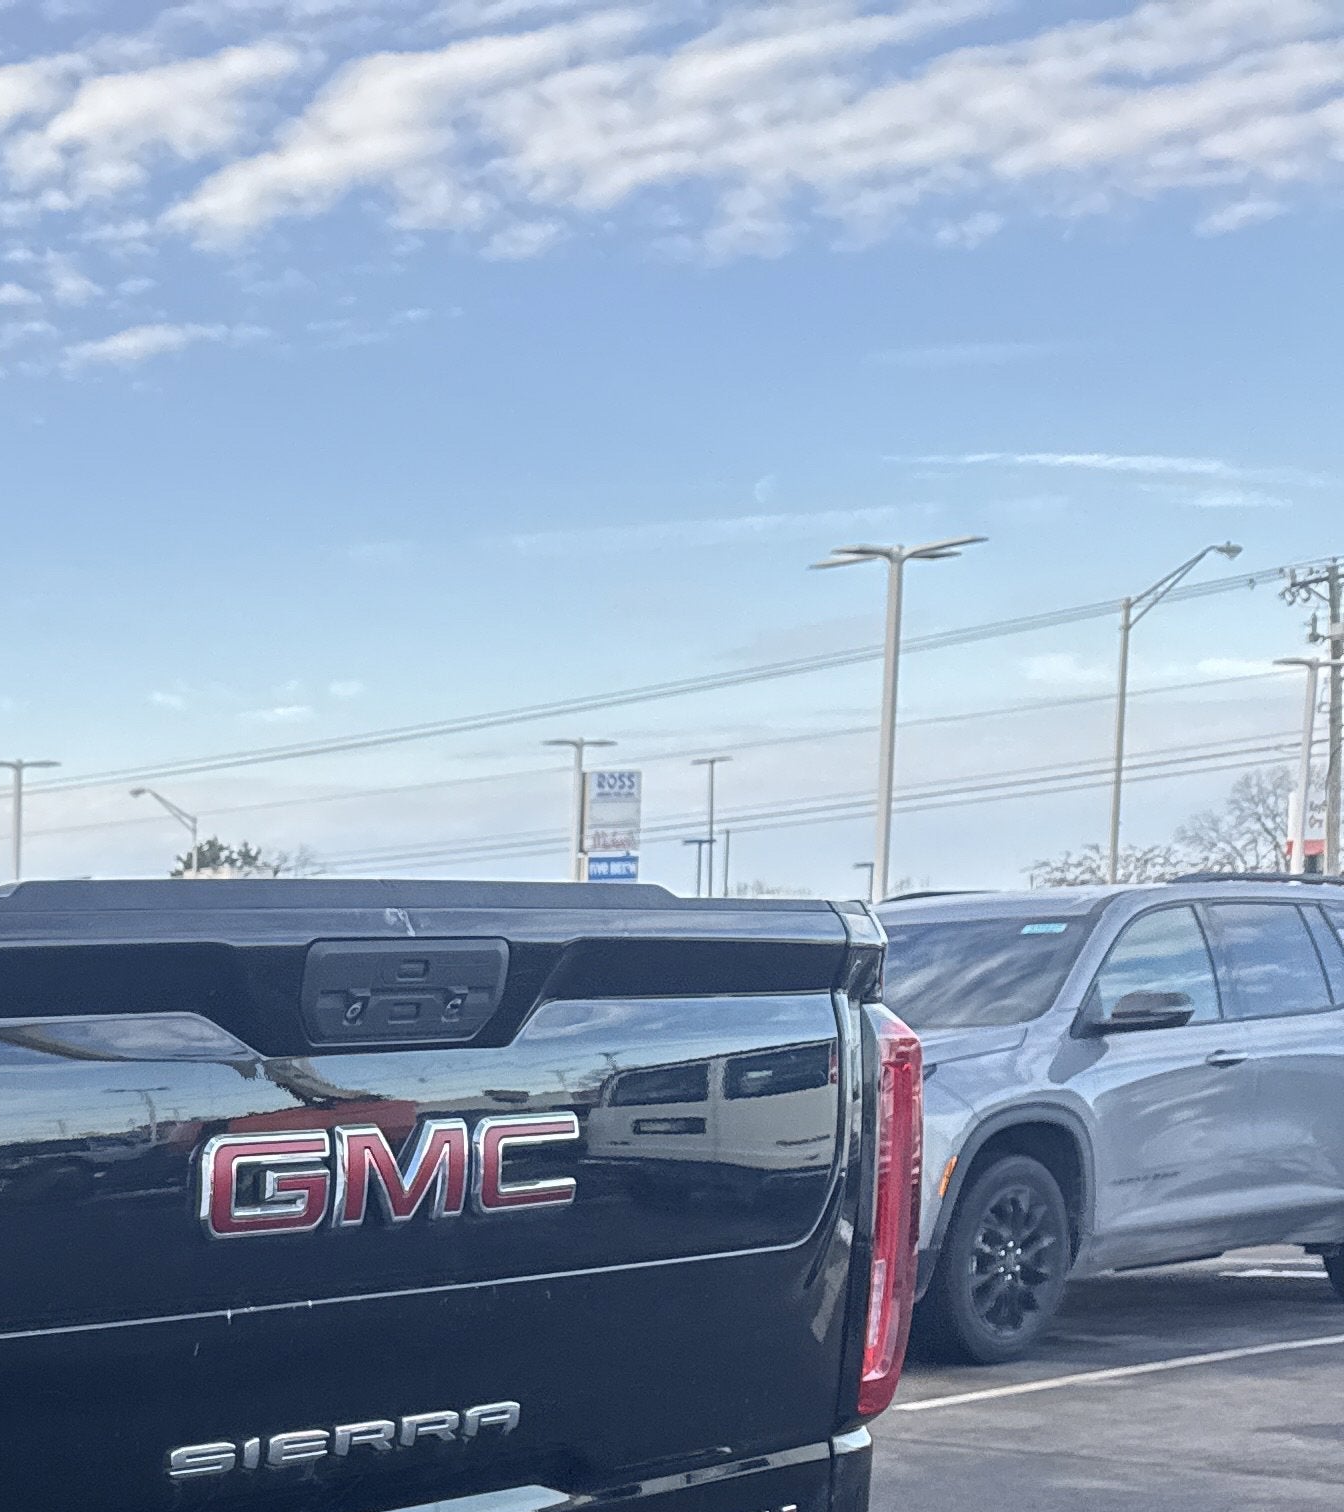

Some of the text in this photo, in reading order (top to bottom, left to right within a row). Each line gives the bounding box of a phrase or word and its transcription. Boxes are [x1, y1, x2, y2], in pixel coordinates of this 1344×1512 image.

[597, 772, 635, 790] ROSS
[200, 1110, 580, 1239] GMC
[170, 1400, 520, 1478] SIERRA
